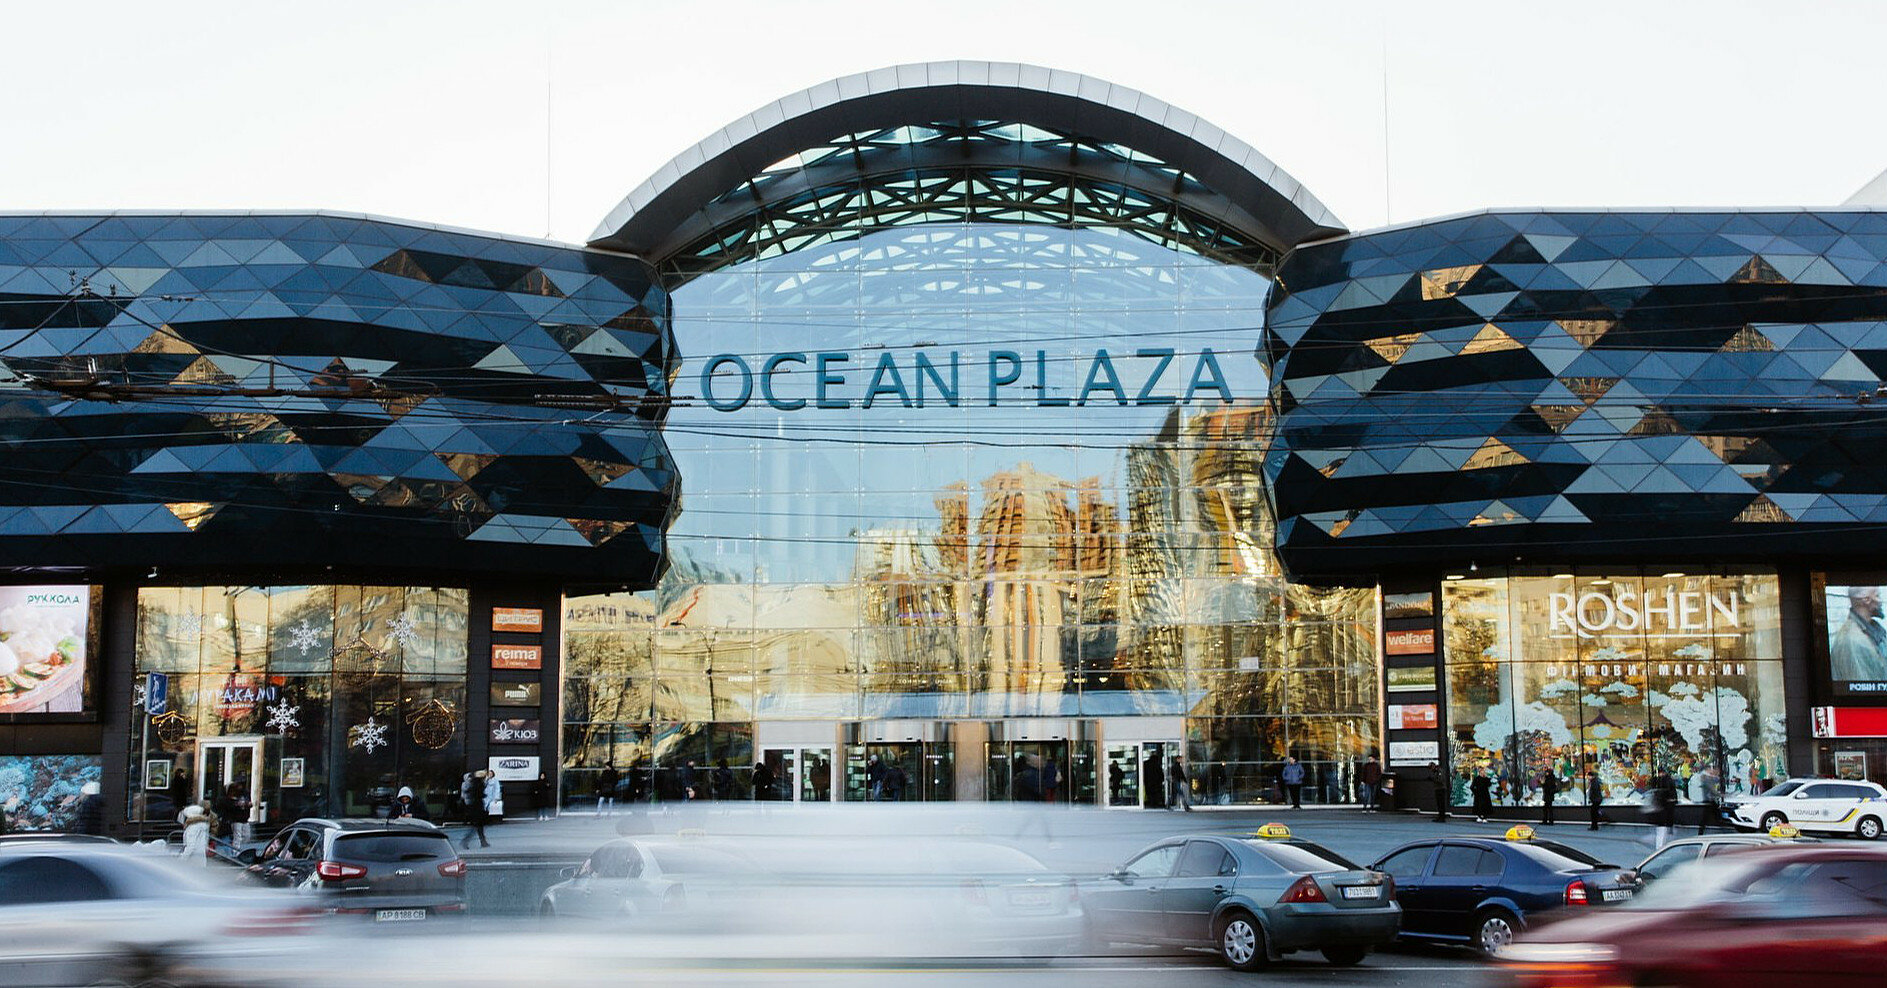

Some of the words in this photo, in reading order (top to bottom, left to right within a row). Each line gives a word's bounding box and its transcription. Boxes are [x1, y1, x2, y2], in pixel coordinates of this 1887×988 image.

[700, 351, 959, 412] OCEAN
[989, 348, 1234, 407] PLAZA
[27, 594, 80, 604] РУККОЛА
[1549, 592, 1739, 637] ROSHEN
[1388, 632, 1432, 645] welfare
[495, 649, 537, 660] reima
[514, 730, 537, 739] КЮЗ
[500, 760, 530, 768] ZARINA
